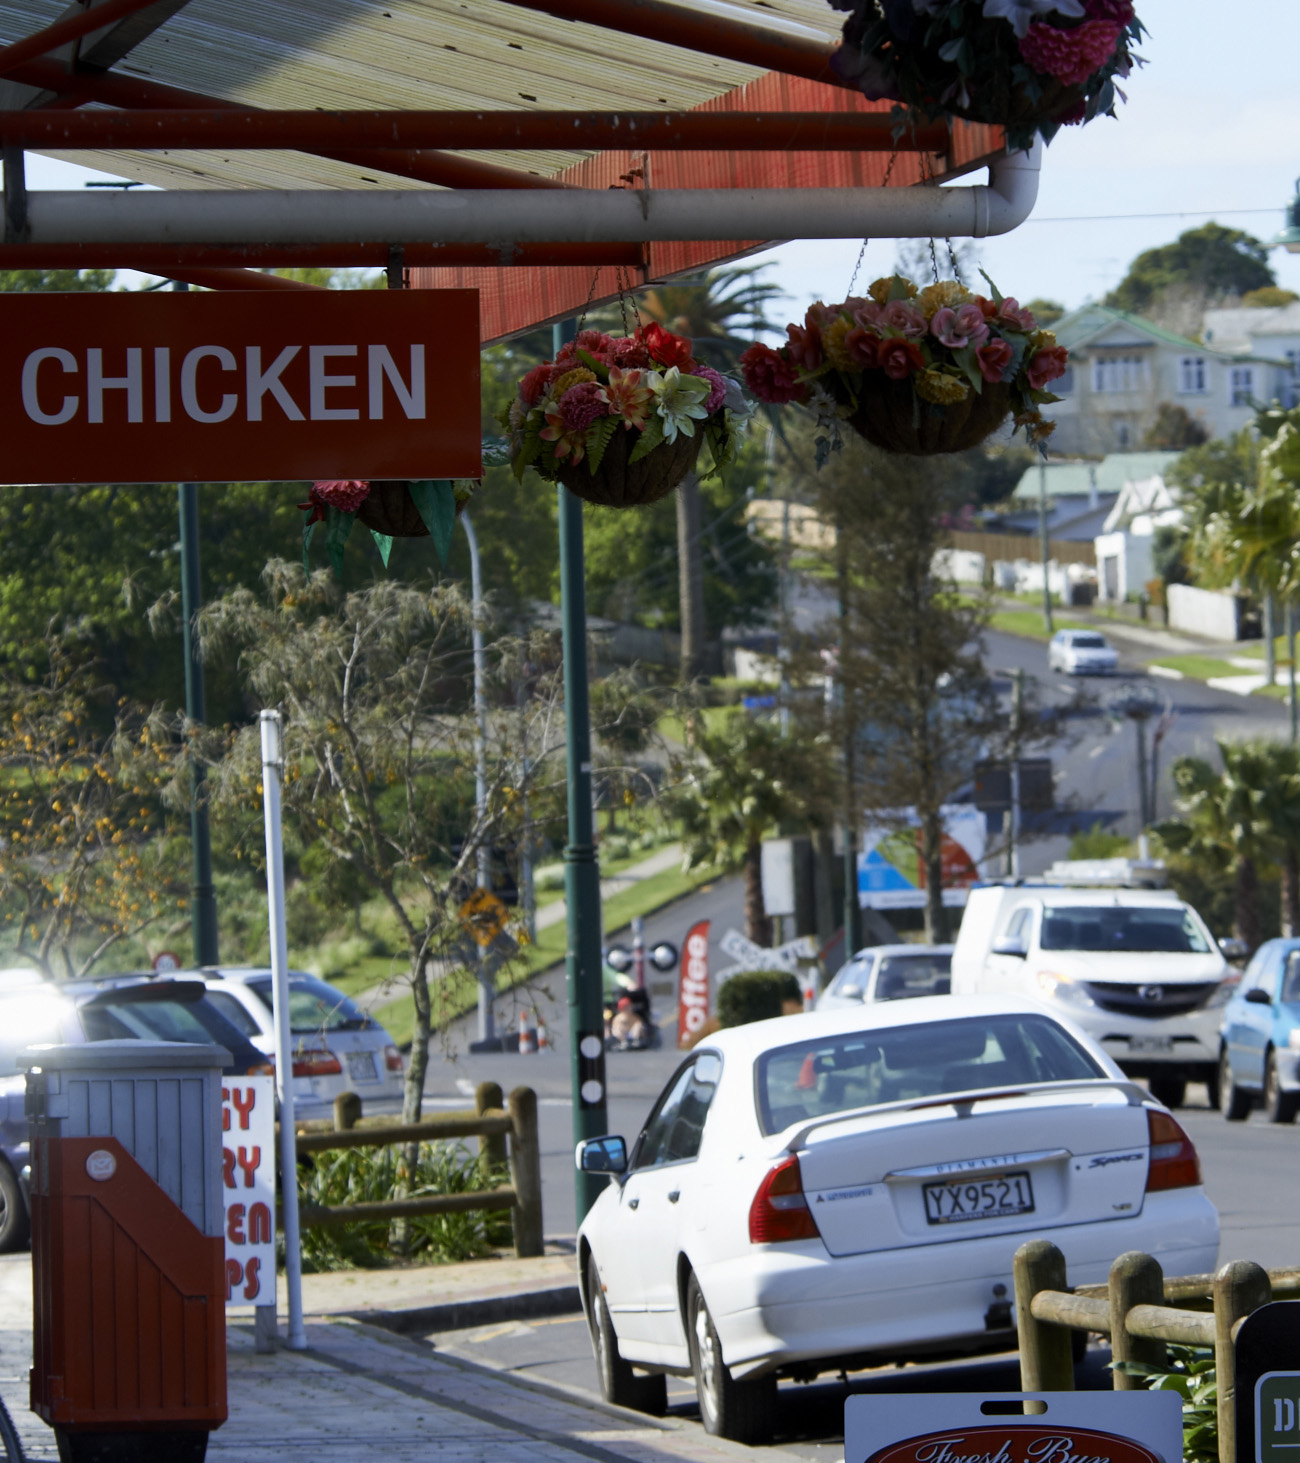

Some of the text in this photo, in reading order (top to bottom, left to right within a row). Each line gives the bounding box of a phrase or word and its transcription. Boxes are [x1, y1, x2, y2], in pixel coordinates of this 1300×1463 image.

[21, 344, 427, 426] CHICKEN
[681, 933, 708, 1042] offee
[936, 1155, 1020, 1174] DIAMANTE
[929, 1180, 1027, 1217] YX9521
[915, 1438, 1013, 1463] Fresh
